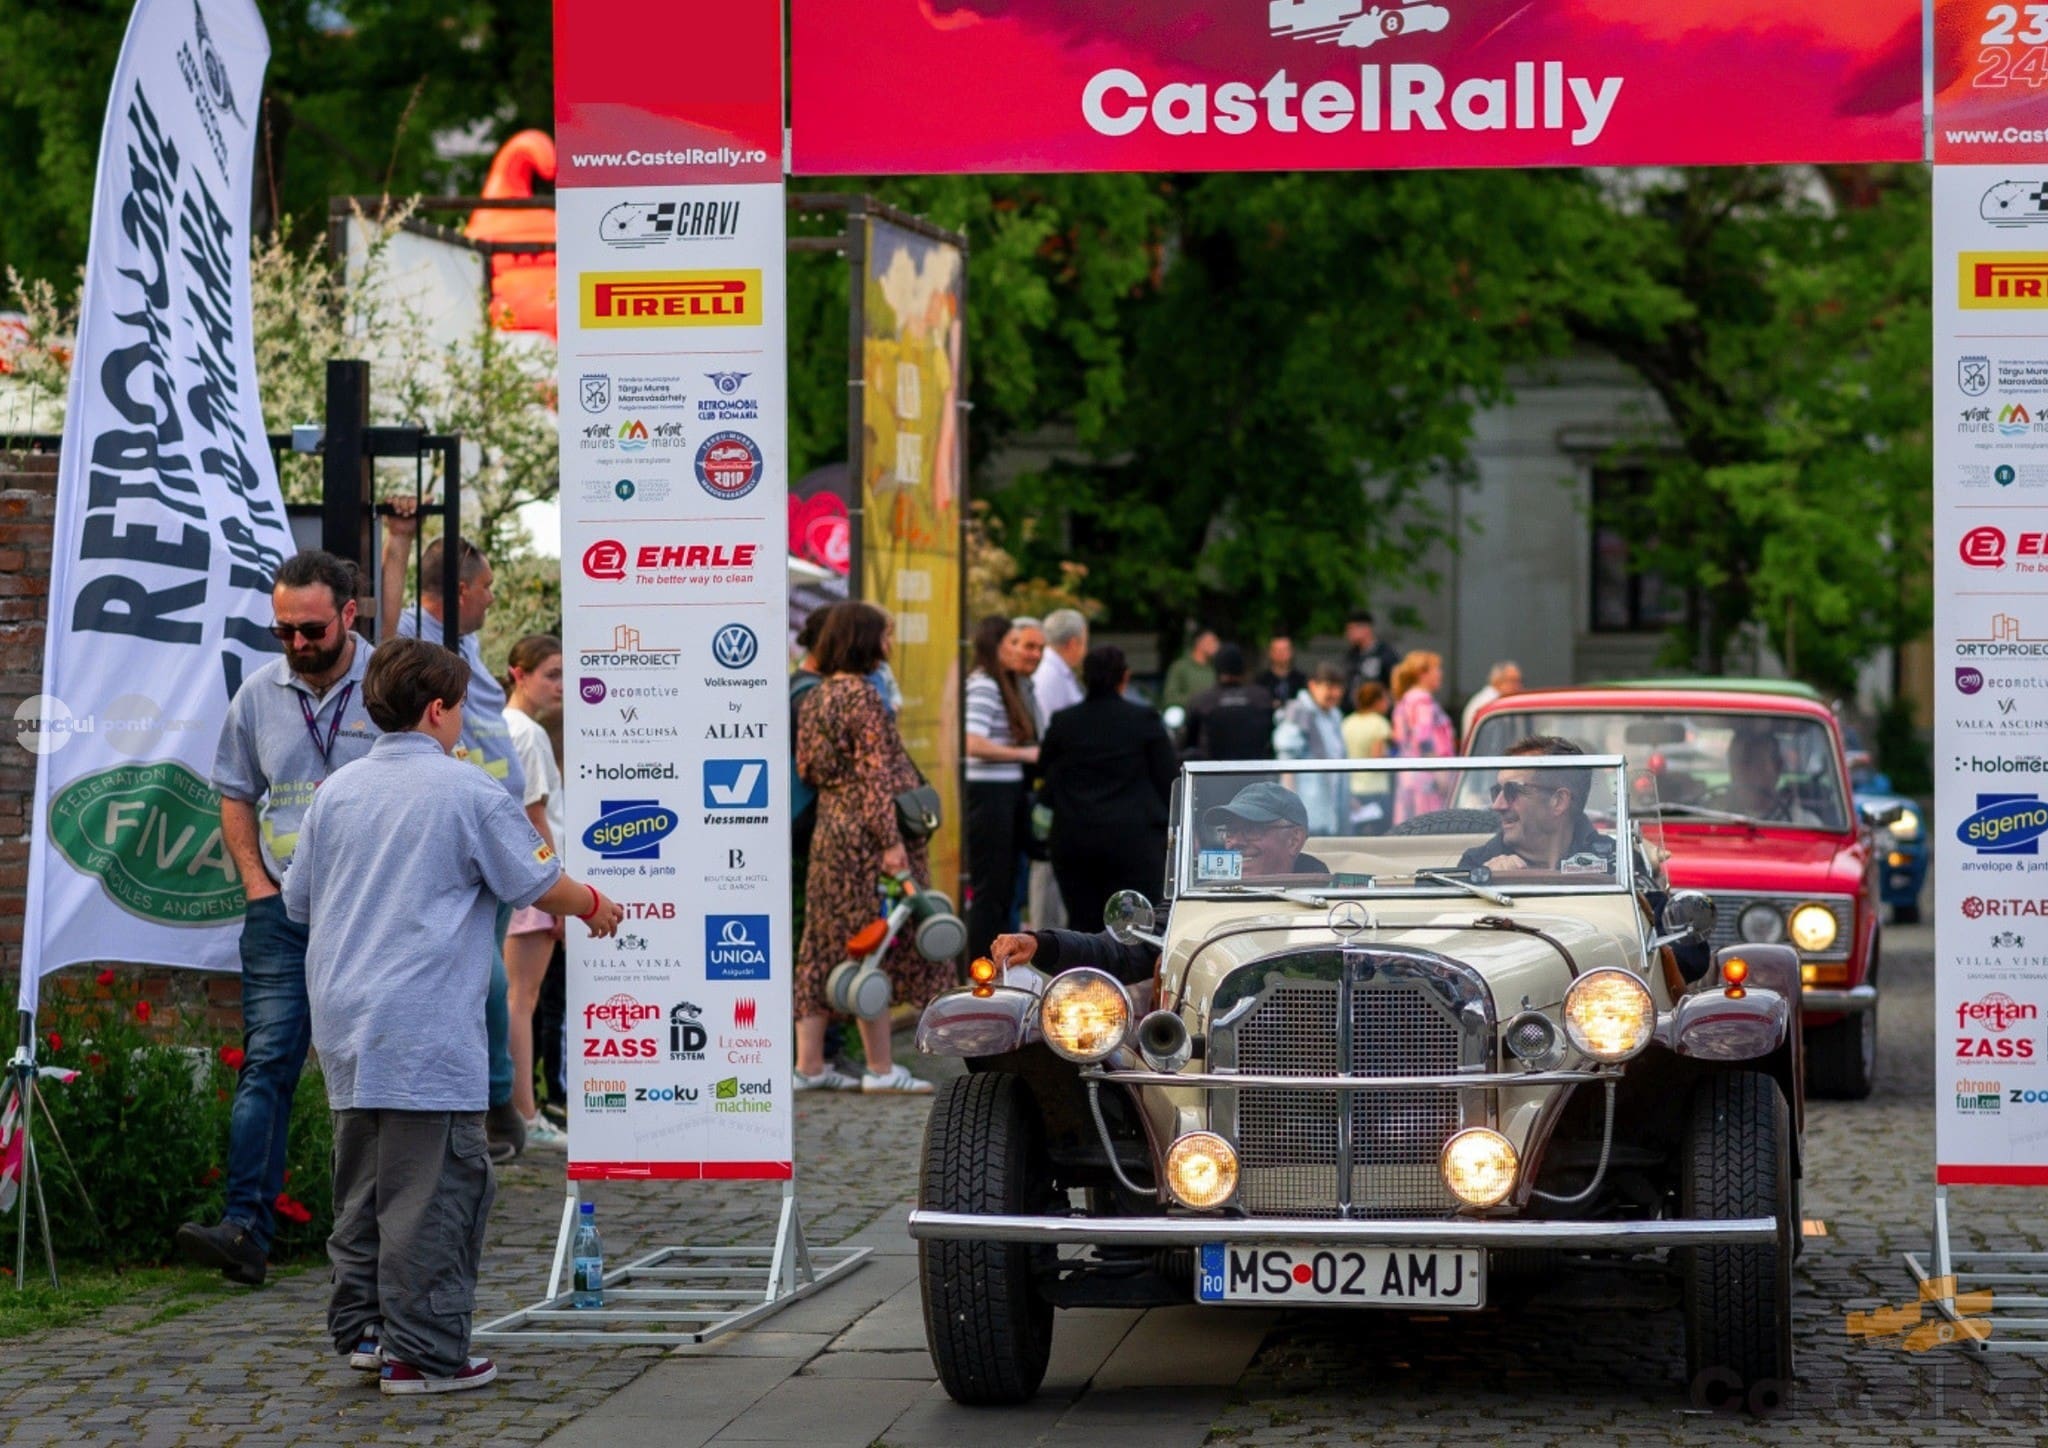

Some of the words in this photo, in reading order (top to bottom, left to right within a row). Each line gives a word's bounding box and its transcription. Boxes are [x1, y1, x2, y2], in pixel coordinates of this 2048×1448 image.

[1980, 4, 2048, 45] 23
[1973, 46, 2048, 88] 24
[1082, 61, 1625, 147] CastelRally
[572, 147, 767, 167] www.CastelRally.ro
[1974, 263, 2048, 297] PIR
[595, 281, 747, 317] PIRELLI
[698, 399, 758, 410] RETROMOBIL
[698, 411, 716, 420] CLUB
[719, 411, 758, 420] ROMANIA
[636, 544, 757, 568] EHRLE
[2015, 562, 2035, 573] The
[635, 574, 654, 585] The
[656, 573, 687, 585] better
[690, 575, 710, 586] way
[712, 573, 723, 583] to
[726, 573, 754, 583] clean
[580, 653, 681, 666] ORTOPROIECT
[610, 685, 679, 698] ecomotive
[704, 677, 768, 689] Volkswagen
[729, 701, 742, 712] by
[580, 727, 617, 737] VALEA
[704, 723, 768, 739] ALIAT
[1955, 719, 1994, 729] VALEA
[59, 767, 166, 817] FEDERATION
[173, 772, 222, 807] INTERN
[593, 815, 669, 846] sigemo
[1968, 809, 2048, 841] sigemo
[105, 800, 237, 883] FIVA
[587, 866, 636, 877] anvelope
[638, 865, 647, 876] &
[649, 865, 676, 877] jante
[1961, 860, 2013, 873] anvelope
[2015, 860, 2025, 872] &
[162, 894, 248, 917] ANCIENS
[583, 959, 627, 968] VILLA
[711, 950, 766, 964] UNIQA
[1955, 957, 2003, 966] VILLA
[583, 1002, 661, 1030] fertan
[1955, 1001, 2038, 1030] fertan
[583, 1038, 657, 1058] ZASS
[1955, 1037, 2034, 1058] ZASS
[670, 1052, 706, 1061] SYSTEM
[584, 1077, 627, 1092] chrono
[634, 1084, 699, 1102] zooku
[739, 1078, 772, 1095] send
[1956, 1077, 2001, 1093] chrono
[715, 1096, 772, 1113] machine
[2009, 1089, 2048, 1104] zoo
[1230, 1250, 1293, 1294] MS
[1312, 1251, 1366, 1295] 02
[1380, 1252, 1464, 1297] AMJ
[1203, 1275, 1223, 1293] RO
